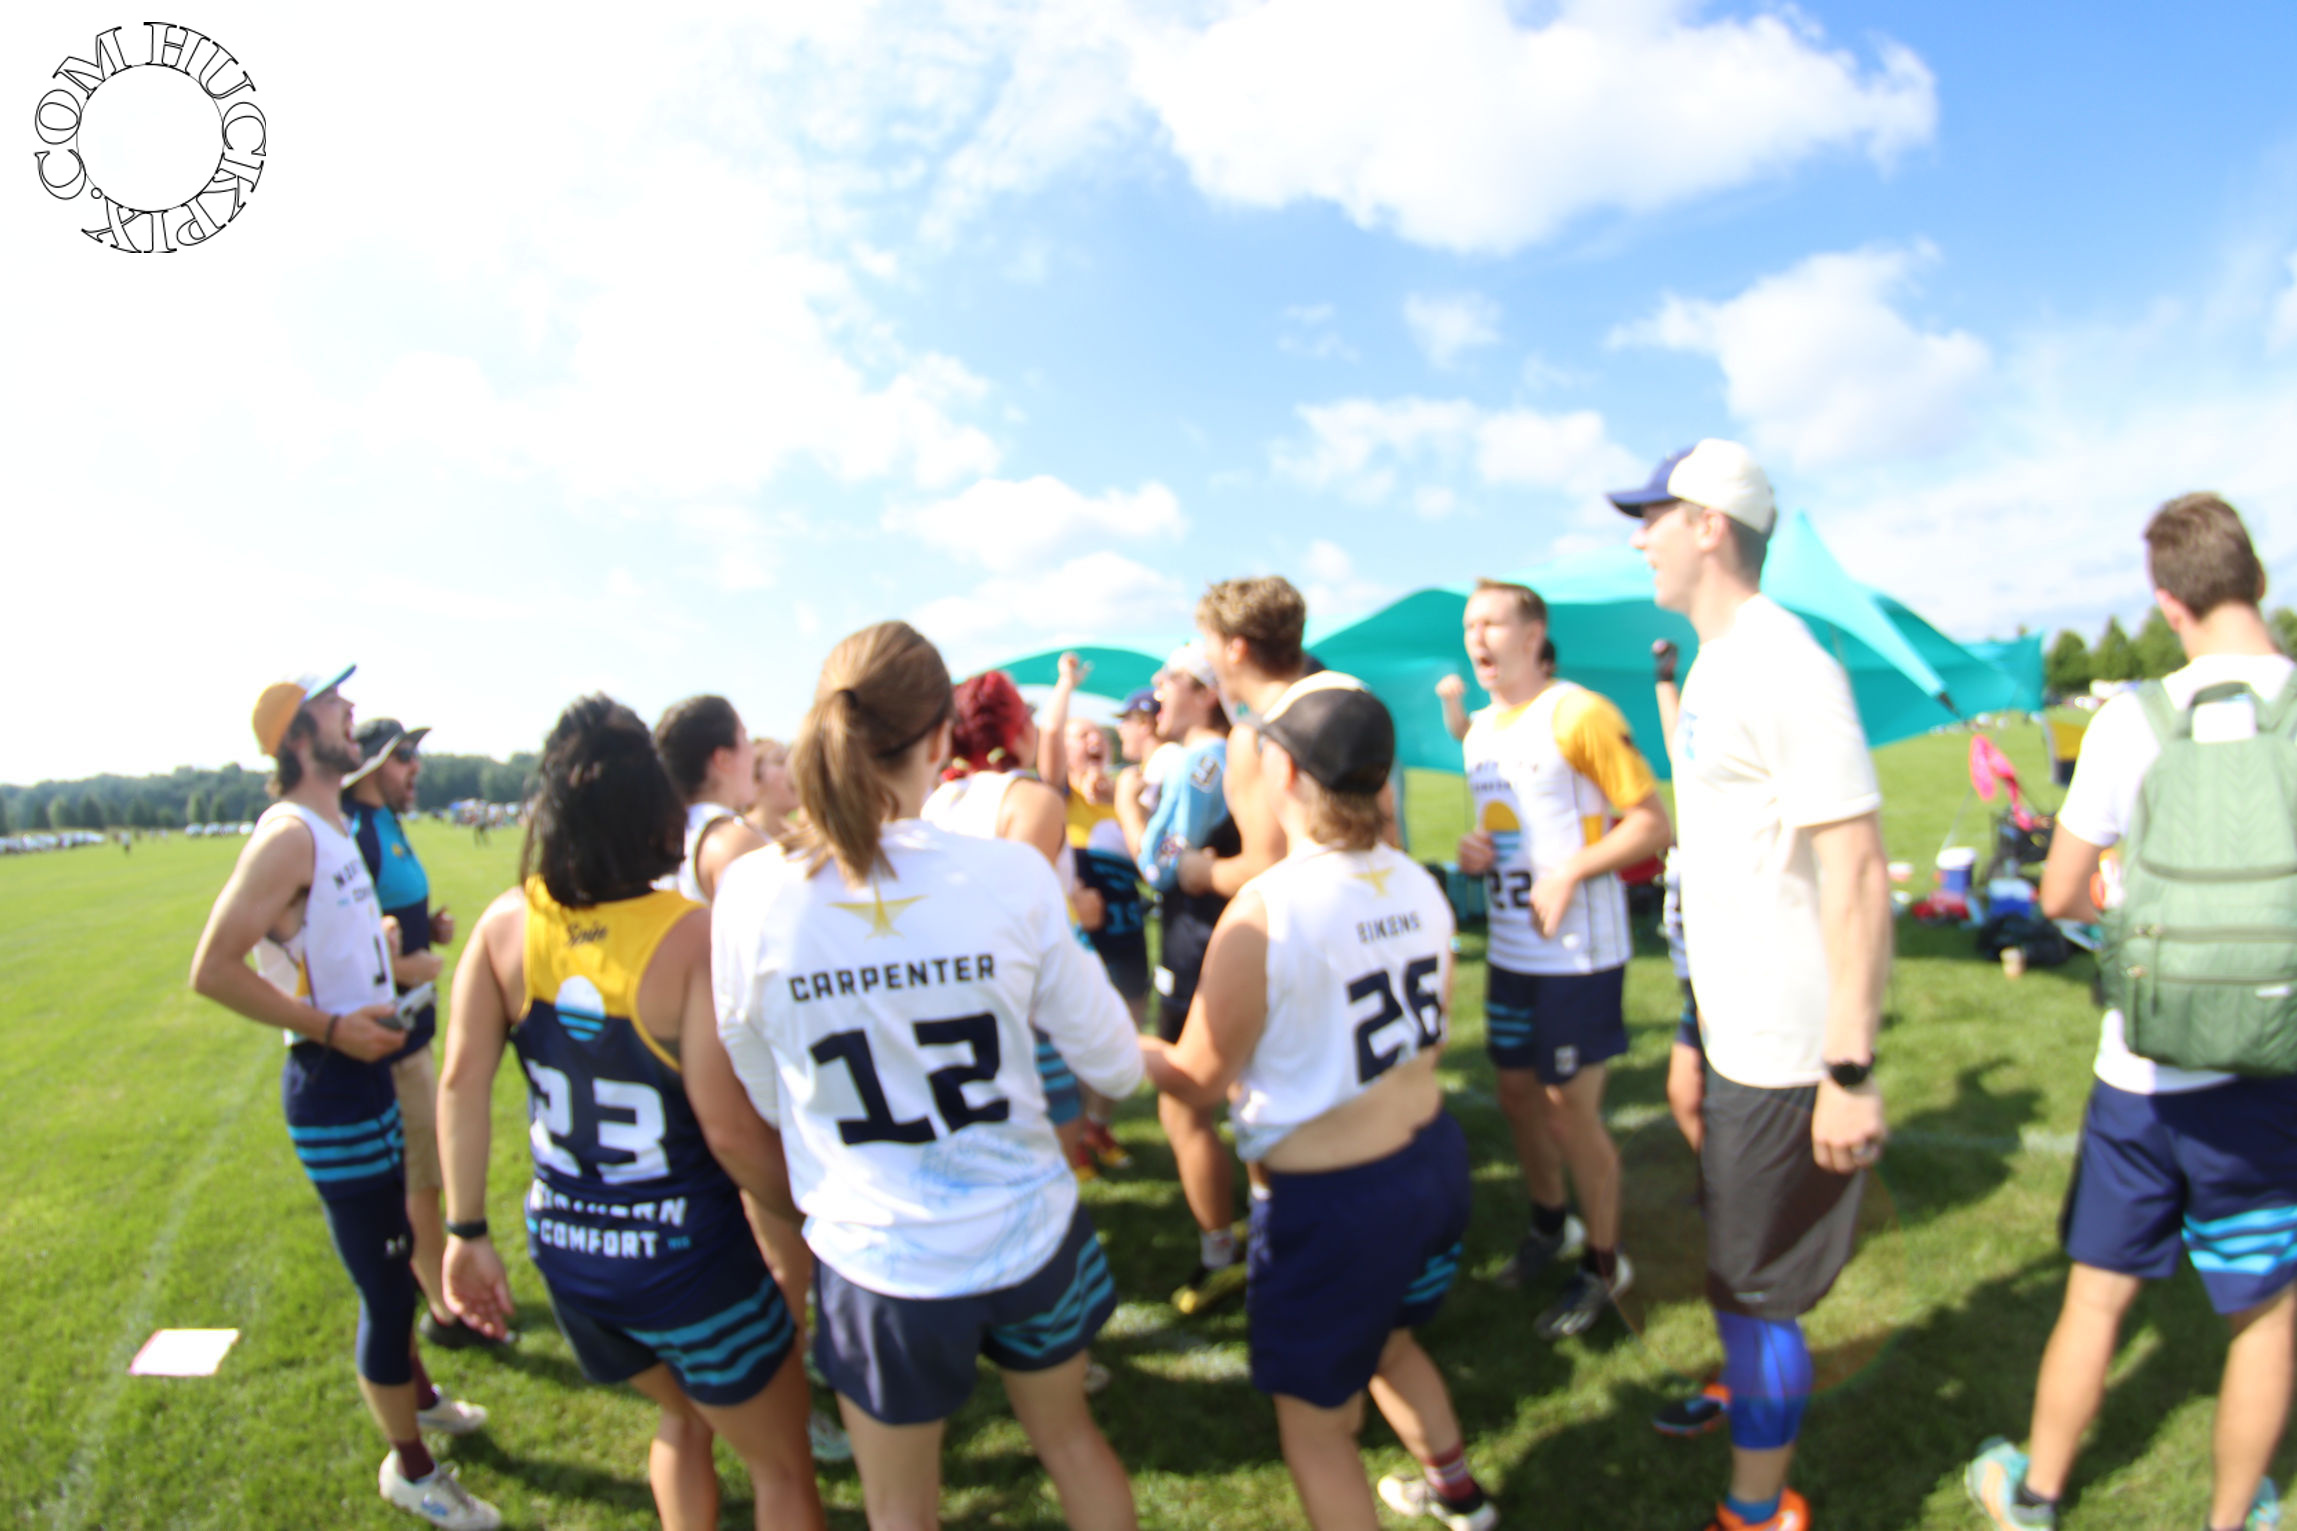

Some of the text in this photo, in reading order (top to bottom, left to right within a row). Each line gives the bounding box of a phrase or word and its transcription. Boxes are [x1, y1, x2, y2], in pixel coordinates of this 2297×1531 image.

[789, 953, 996, 1003] CARPENTER
[1346, 954, 1442, 1087] 26
[525, 1058, 671, 1185] 23
[808, 1010, 1010, 1146] 12
[538, 1217, 659, 1260] COMFORT
